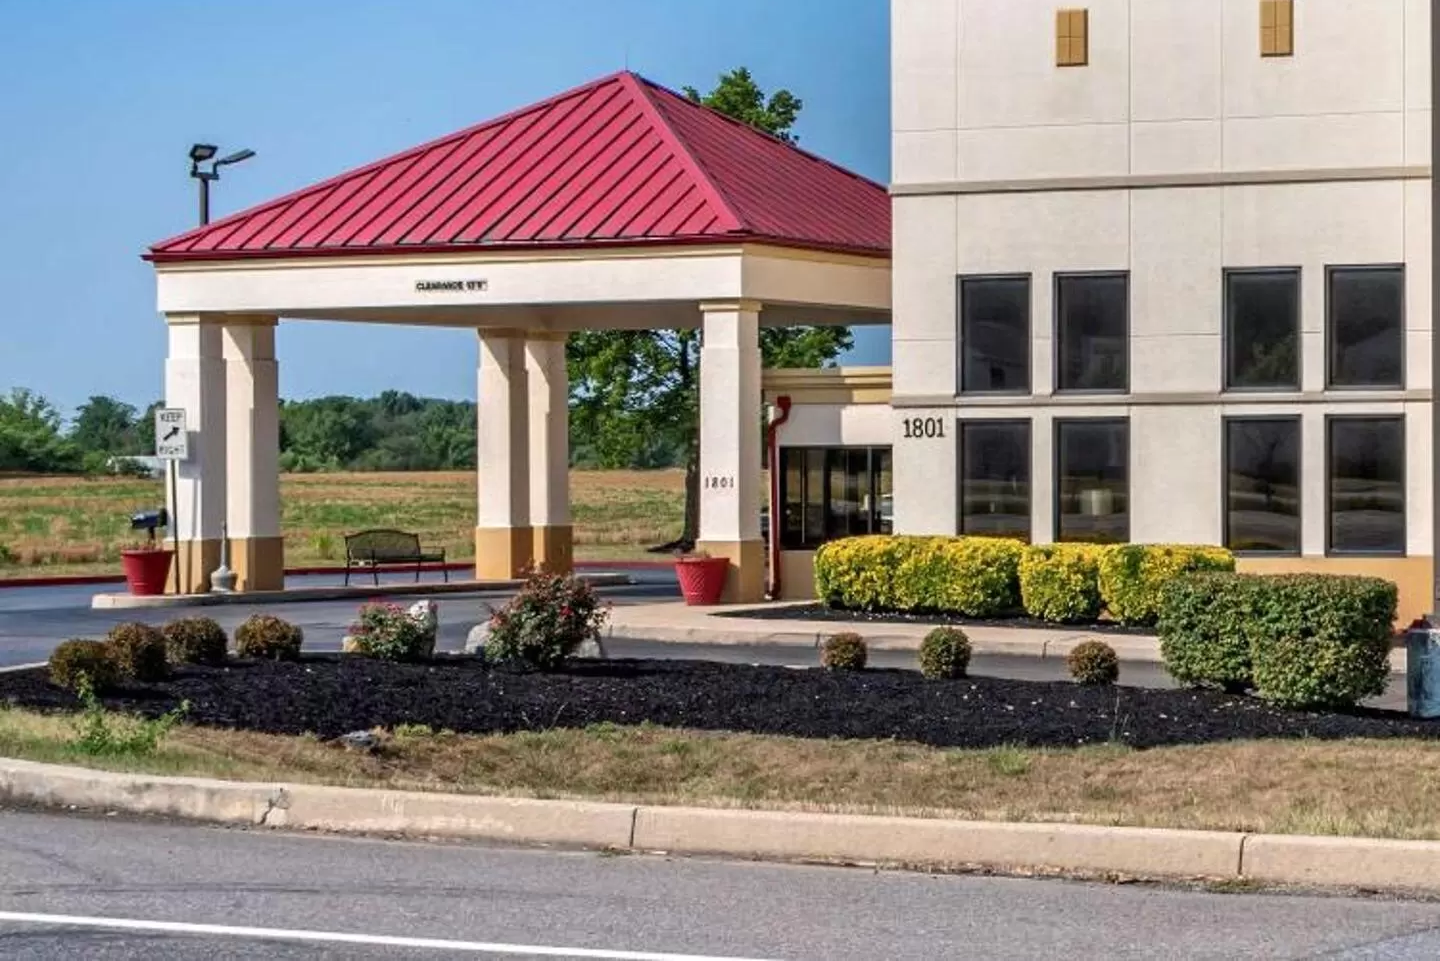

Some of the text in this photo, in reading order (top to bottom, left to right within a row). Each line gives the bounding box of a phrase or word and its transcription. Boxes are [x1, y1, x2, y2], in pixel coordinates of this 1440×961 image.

[160, 412, 182, 422] KEEP
[902, 416, 946, 439] 1801
[704, 476, 734, 489] 1801
